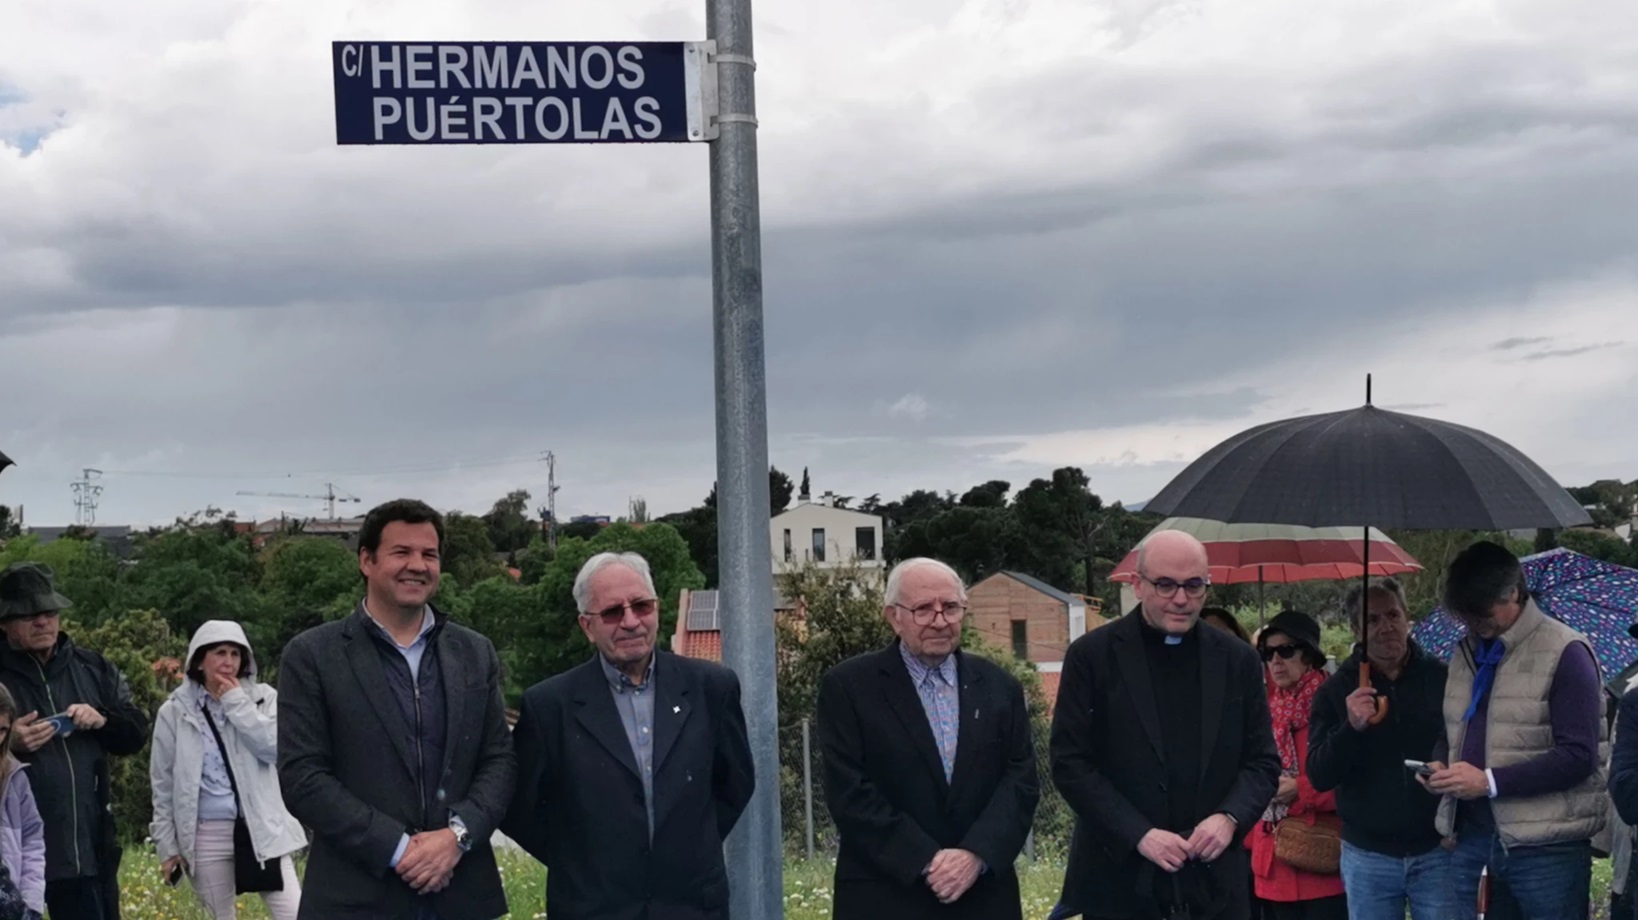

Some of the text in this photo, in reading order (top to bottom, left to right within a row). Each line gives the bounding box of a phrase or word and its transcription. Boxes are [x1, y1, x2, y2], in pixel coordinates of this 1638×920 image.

[341, 44, 646, 89] C/ HERMANOS
[373, 96, 662, 141] PUÉRTOLAS
